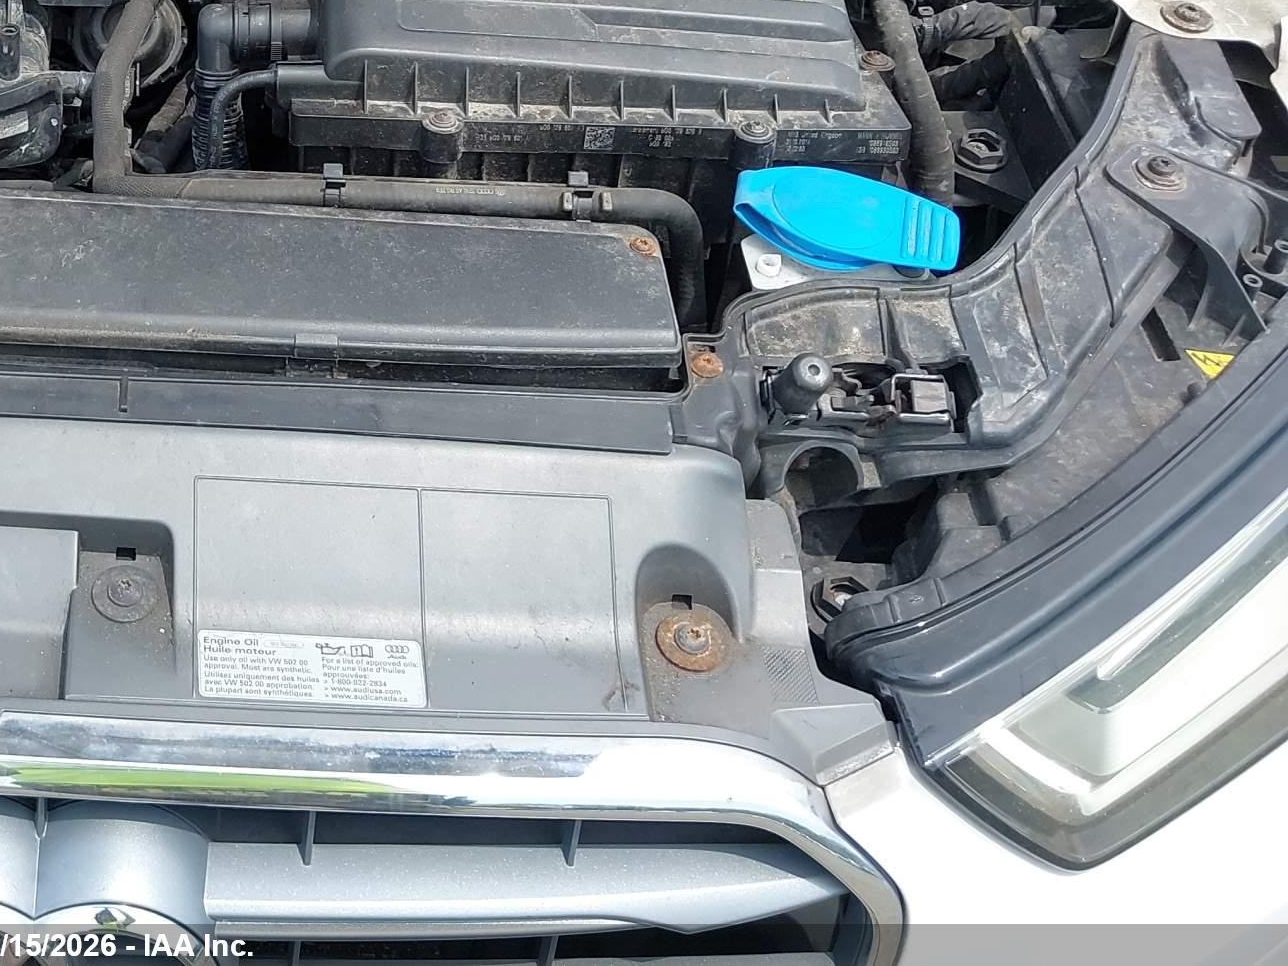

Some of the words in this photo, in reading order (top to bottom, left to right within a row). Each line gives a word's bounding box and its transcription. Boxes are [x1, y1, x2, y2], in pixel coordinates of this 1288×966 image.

[203, 636, 240, 647] Engine
[244, 638, 259, 646] Oil
[203, 645, 232, 653] Huile
[235, 647, 277, 656] moteur
[322, 663, 340, 671] Pour
[375, 666, 406, 674] d'huiles
[365, 659, 401, 668] approved
[233, 672, 280, 682] uniquement
[281, 674, 295, 682] des
[297, 675, 320, 683] huiles
[204, 685, 214, 693] La
[215, 686, 242, 695] plupart
